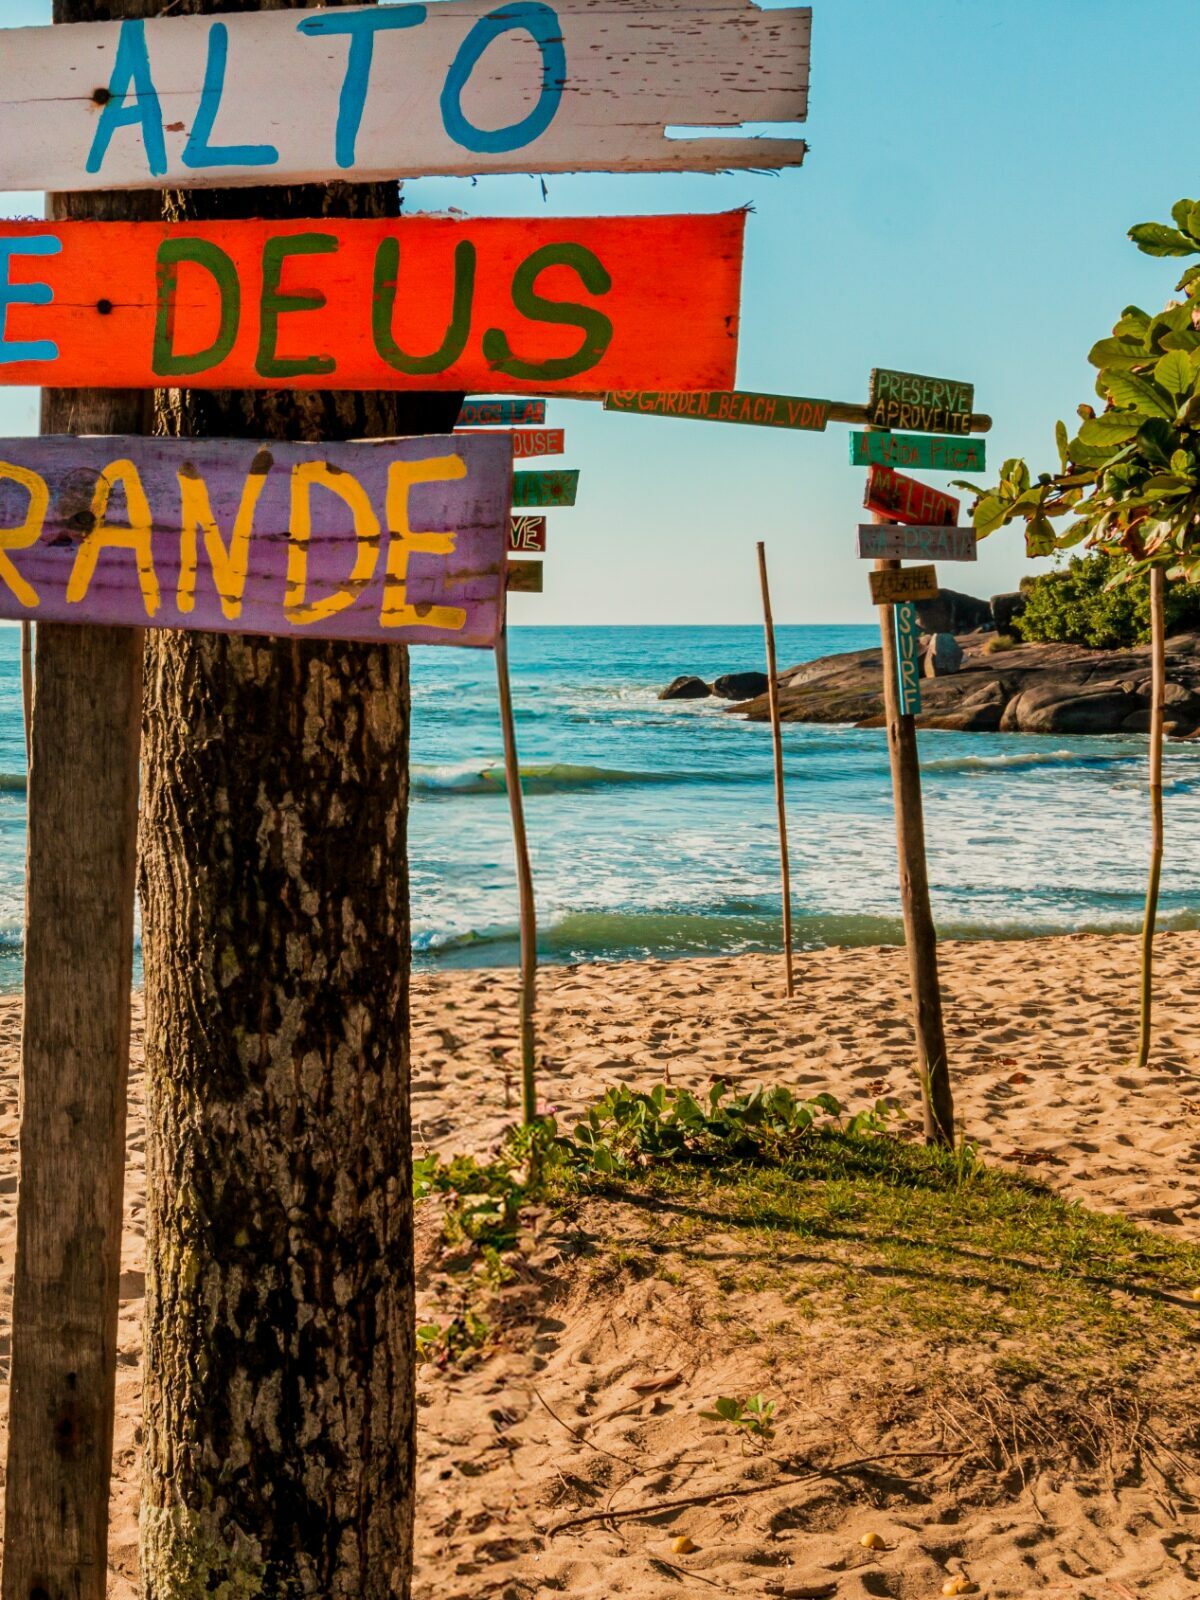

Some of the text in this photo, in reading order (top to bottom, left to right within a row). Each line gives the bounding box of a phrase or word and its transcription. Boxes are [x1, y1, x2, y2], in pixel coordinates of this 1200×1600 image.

[86, 1, 567, 176] ALTO
[152, 233, 613, 381] DEUS
[860, 433, 871, 459] A
[878, 373, 968, 412] PRESERVE
[899, 607, 916, 714] SURF
